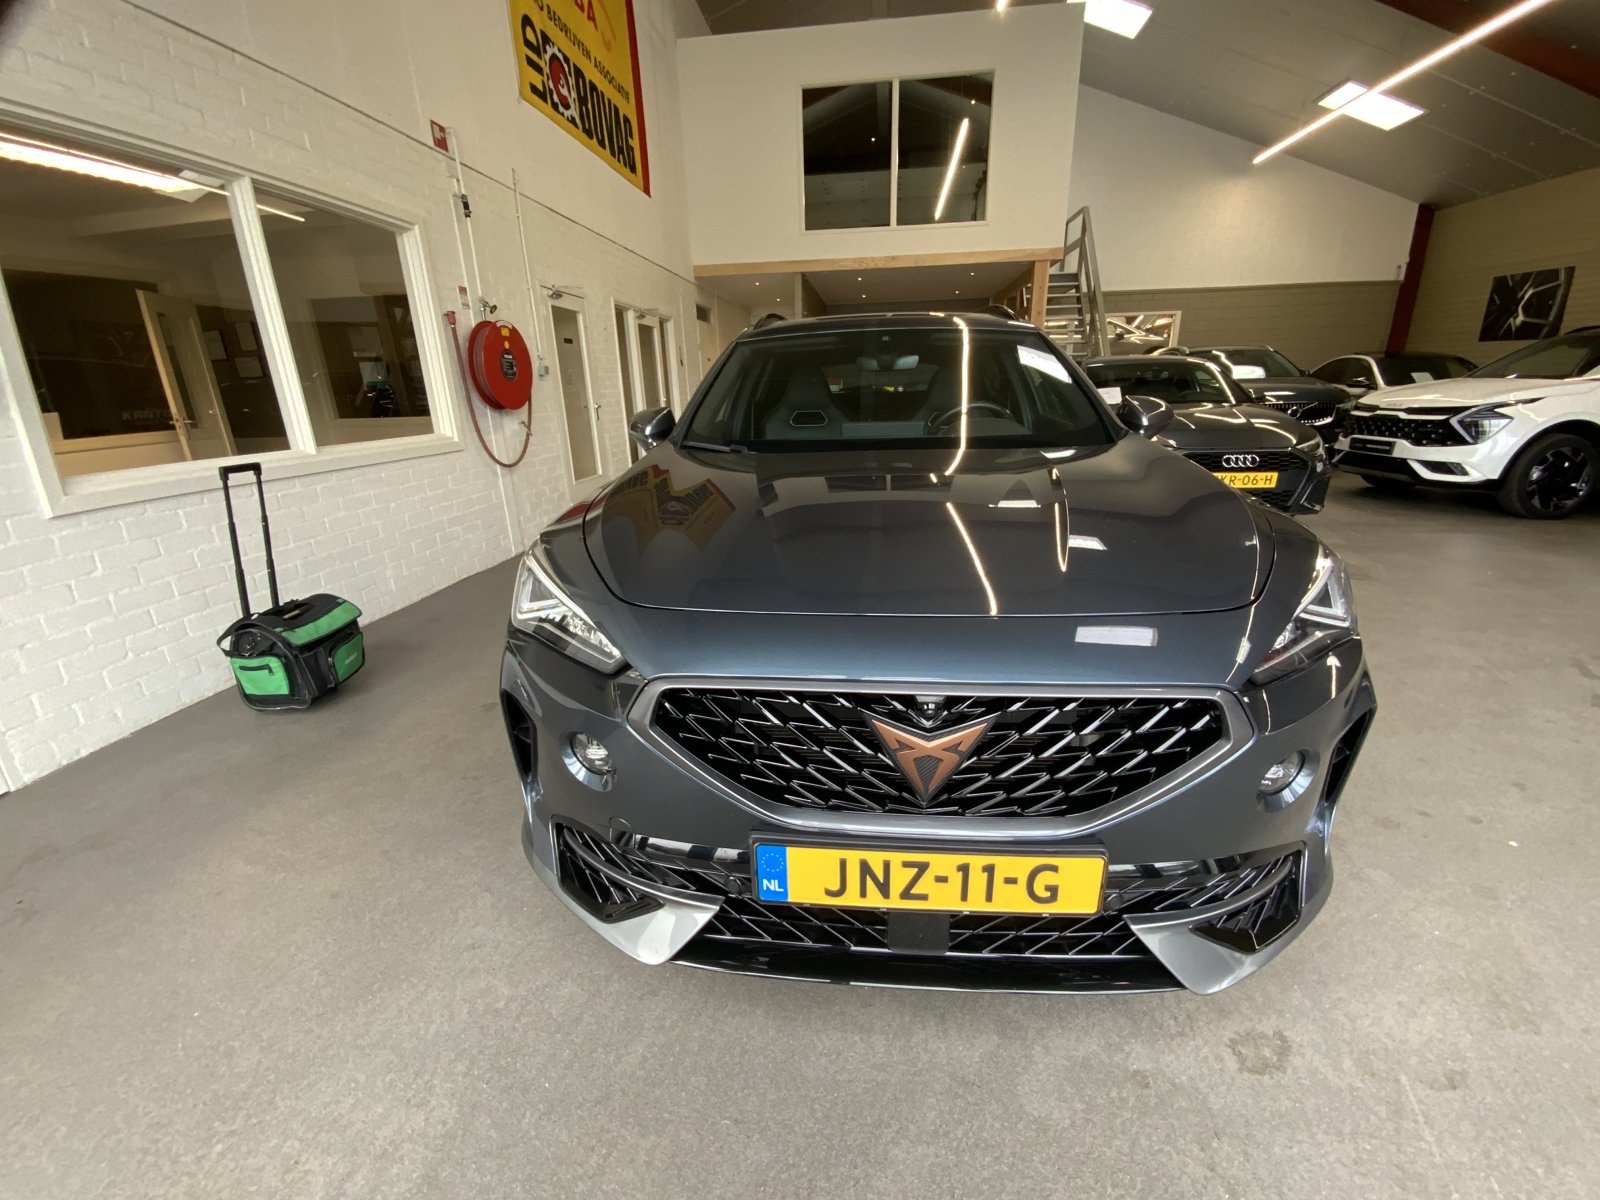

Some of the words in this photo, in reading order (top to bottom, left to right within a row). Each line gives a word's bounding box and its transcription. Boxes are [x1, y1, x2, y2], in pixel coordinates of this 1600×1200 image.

[520, 13, 549, 105] LID
[546, 3, 592, 65] BEDRIJVEN
[593, 58, 631, 105] ASSOCIATIE
[572, 62, 638, 177] BOVAG
[1216, 475, 1274, 486] KR-06-H
[762, 878, 785, 893] NL
[824, 857, 1061, 905] JNZ-11-G
